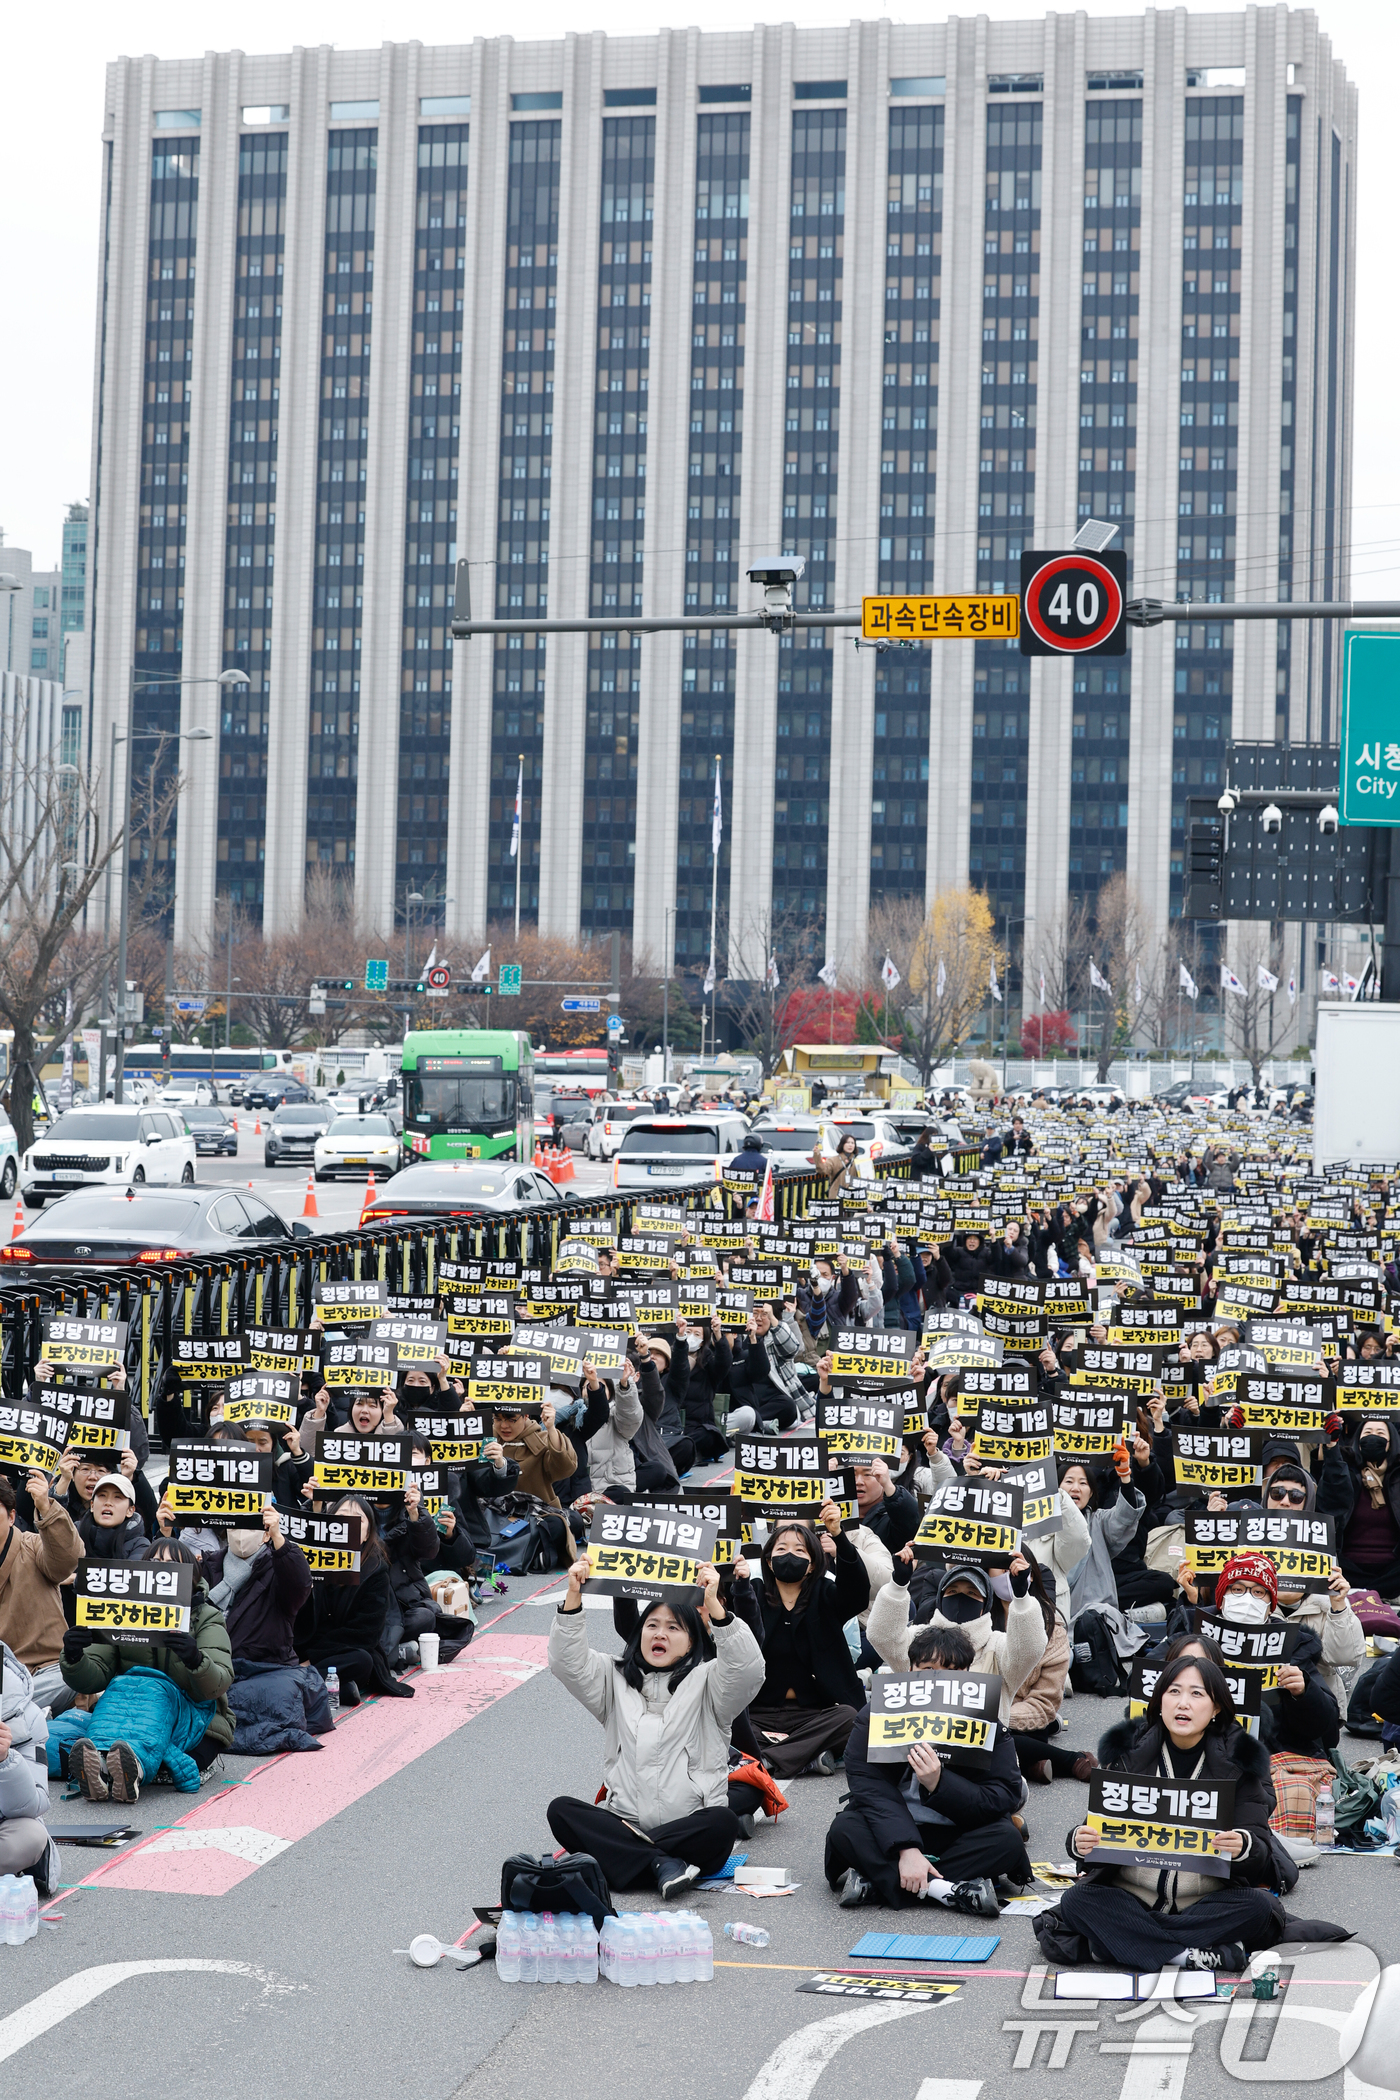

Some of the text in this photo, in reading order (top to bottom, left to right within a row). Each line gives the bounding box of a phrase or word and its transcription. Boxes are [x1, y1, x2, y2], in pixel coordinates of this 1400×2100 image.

[1048, 582, 1099, 625] 40
[871, 603, 1012, 632] 과속단속장비
[1355, 742, 1400, 771] 시청
[1356, 775, 1398, 799] City
[432, 972, 446, 984] 40
[723, 1170, 753, 1180] 정당가입
[724, 1181, 754, 1191] 보장하라!
[641, 1206, 681, 1219] 정당가입
[955, 1208, 989, 1219] 정당가입
[1144, 1206, 1176, 1217] 정당가입
[569, 1221, 612, 1233] 정당가입
[641, 1220, 682, 1231] 보장하라!
[704, 1222, 743, 1234] 정당가입
[793, 1227, 836, 1239] 정당가입
[622, 1239, 668, 1253] 정당가입
[703, 1237, 746, 1247] 보장하라!
[764, 1240, 809, 1255] 정당가입
[1227, 1234, 1268, 1246] 정당가입
[1338, 1236, 1377, 1247] 정당가입
[621, 1253, 669, 1268] 보장하라!
[1228, 1259, 1271, 1273] 정당가입
[732, 1268, 777, 1282] 정당가입
[1154, 1276, 1193, 1291] 정당가입
[321, 1286, 379, 1301] 정당가입
[532, 1284, 582, 1300] 정당가입
[984, 1278, 1039, 1300] 정당가입
[1224, 1286, 1274, 1308] 정당가입
[1286, 1285, 1338, 1300] 정당가입
[324, 1306, 383, 1319] 보장하라!
[453, 1298, 508, 1315] 정당가입
[580, 1302, 630, 1318] 정당가입
[680, 1305, 711, 1316] 하라!
[1044, 1302, 1087, 1314] 장하라!
[928, 1313, 979, 1335] 정당가입
[985, 1313, 1040, 1334] 정당가입
[1122, 1309, 1177, 1324] 정당가입
[49, 1322, 117, 1342] 정당가입
[376, 1322, 438, 1340] 정당가입
[454, 1319, 511, 1333] 보장하라!
[517, 1330, 580, 1353] 정당가입
[837, 1332, 906, 1353] 정당가입
[1122, 1329, 1180, 1342] 보장하라!
[1251, 1325, 1314, 1346] 정당가입
[48, 1346, 118, 1363] 보장하라!
[178, 1340, 241, 1358] 정당가입
[330, 1346, 389, 1364] 정당가입
[932, 1338, 996, 1355] 정당가입
[1264, 1346, 1316, 1364] 장하라!
[251, 1352, 298, 1370] 장하라!
[476, 1361, 540, 1378] 정당가입
[837, 1356, 908, 1376] 보장하라!
[931, 1355, 998, 1368] 보장하라!
[1084, 1350, 1152, 1371] 정당가입
[328, 1370, 391, 1385] 보장하라!
[964, 1373, 1029, 1391] 정당가입
[230, 1378, 290, 1398] 정당가입
[476, 1384, 543, 1401] 보장하라!
[1247, 1381, 1323, 1403] 정당가입
[230, 1402, 290, 1420] 보장하라!
[824, 1406, 894, 1429] 정당가입
[1248, 1408, 1326, 1426] 보장하라!
[0, 1406, 68, 1444] 정당가입
[415, 1417, 483, 1437] 정당가입
[981, 1408, 1047, 1433] 정당가입
[71, 1423, 116, 1446] 하라!
[1056, 1434, 1115, 1451] 장하라!
[322, 1439, 400, 1461] 정당가입
[432, 1442, 480, 1460] 장하라
[979, 1438, 1050, 1458] 보장하라!
[1177, 1433, 1251, 1458] 정당가입
[740, 1443, 819, 1470] 정당가입
[176, 1459, 259, 1483] 정당가입
[323, 1467, 404, 1488] 보장하라!
[1182, 1463, 1255, 1484] 보장하라!
[740, 1476, 824, 1501] 보장하라!
[175, 1489, 262, 1512] 보장하라!
[601, 1514, 702, 1550] 정당가입
[917, 1519, 1015, 1550] 보장하라!
[1194, 1518, 1239, 1541] 정당
[1246, 1517, 1328, 1546] 정당가입
[306, 1551, 352, 1569] 하라!
[596, 1550, 699, 1583] 보장하라!
[1264, 1554, 1332, 1576] 장하라!
[86, 1567, 178, 1596] 정당가입
[85, 1601, 180, 1628] 보장하라!
[883, 1679, 986, 1710] 정당가입
[883, 1718, 987, 1746] 보장하라!
[1101, 1781, 1218, 1819] 정당가입
